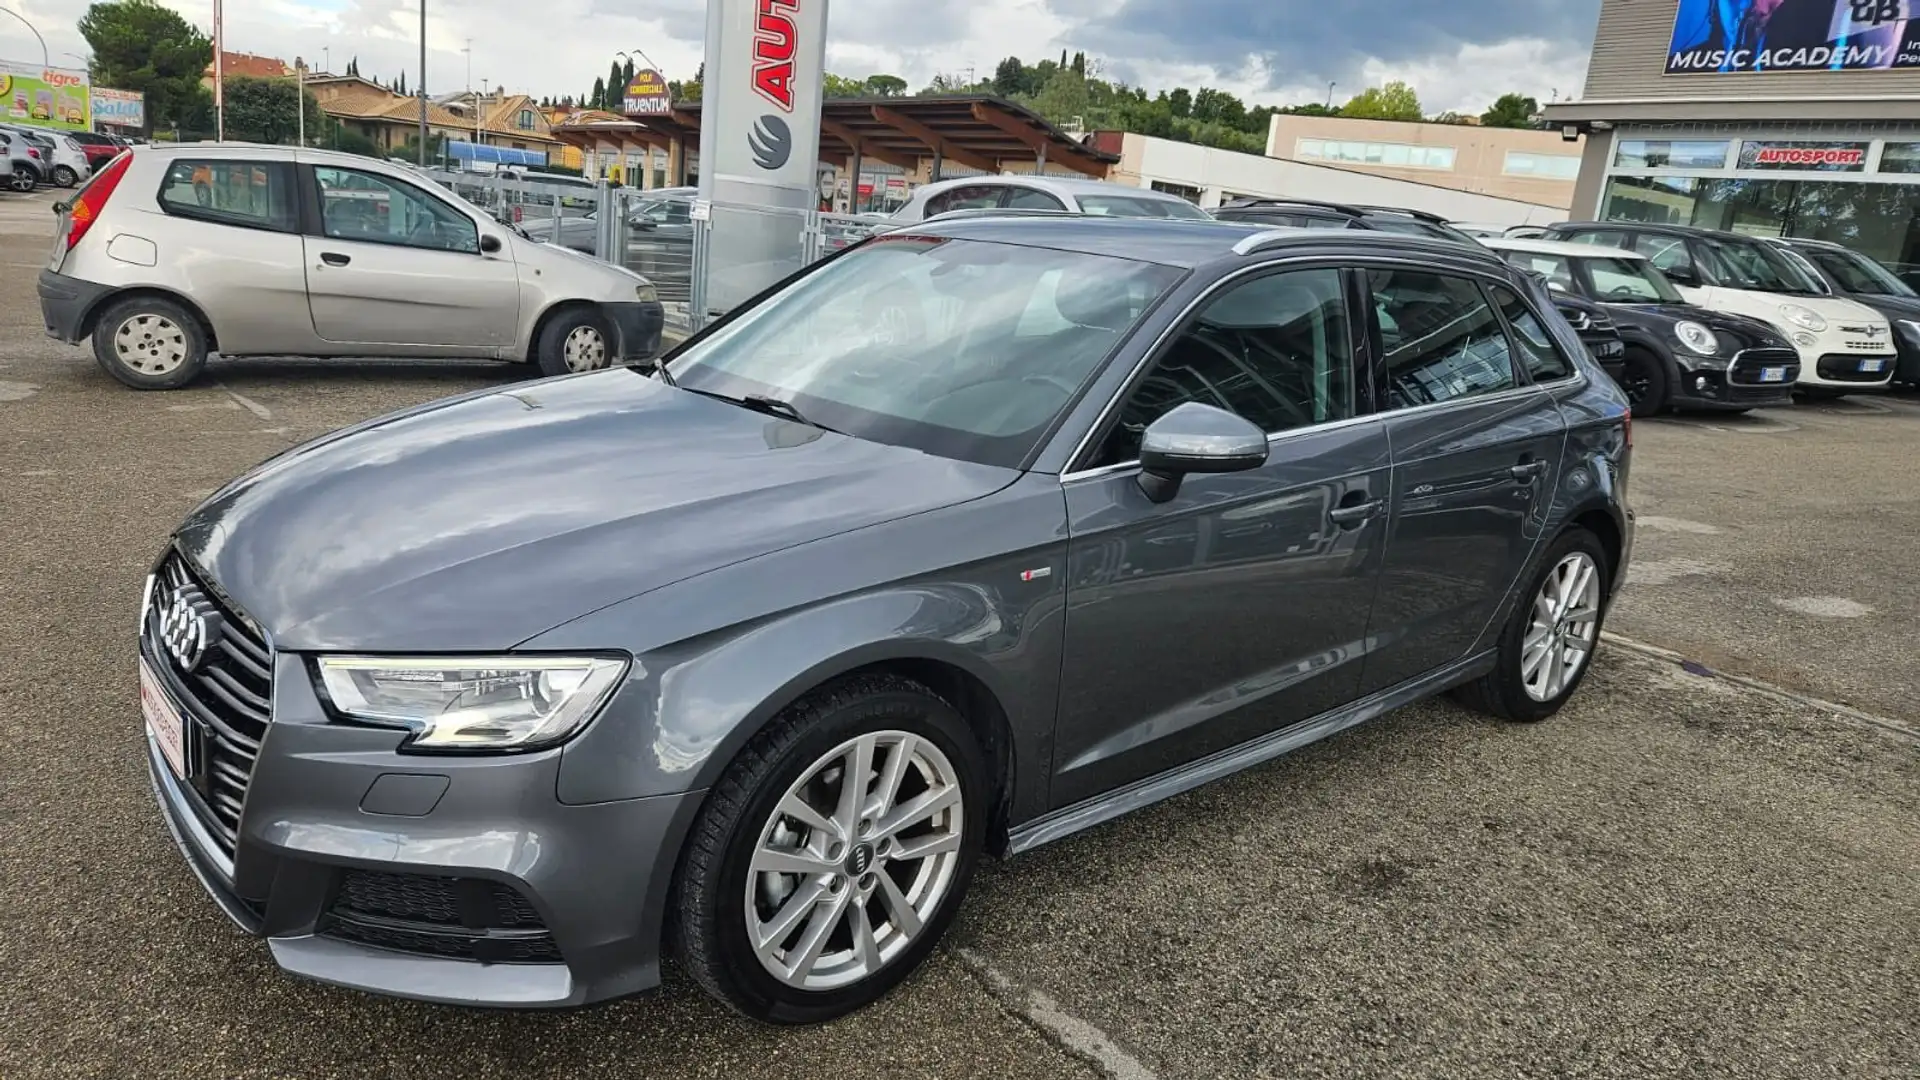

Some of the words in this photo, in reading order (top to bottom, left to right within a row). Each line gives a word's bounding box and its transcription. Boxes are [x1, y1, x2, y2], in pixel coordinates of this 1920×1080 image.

[1670, 50, 1749, 69] MUSIC
[1752, 46, 1890, 67] ACADEMY
[43, 69, 81, 87] tigre
[1757, 148, 1863, 164] AUTOSPORT
